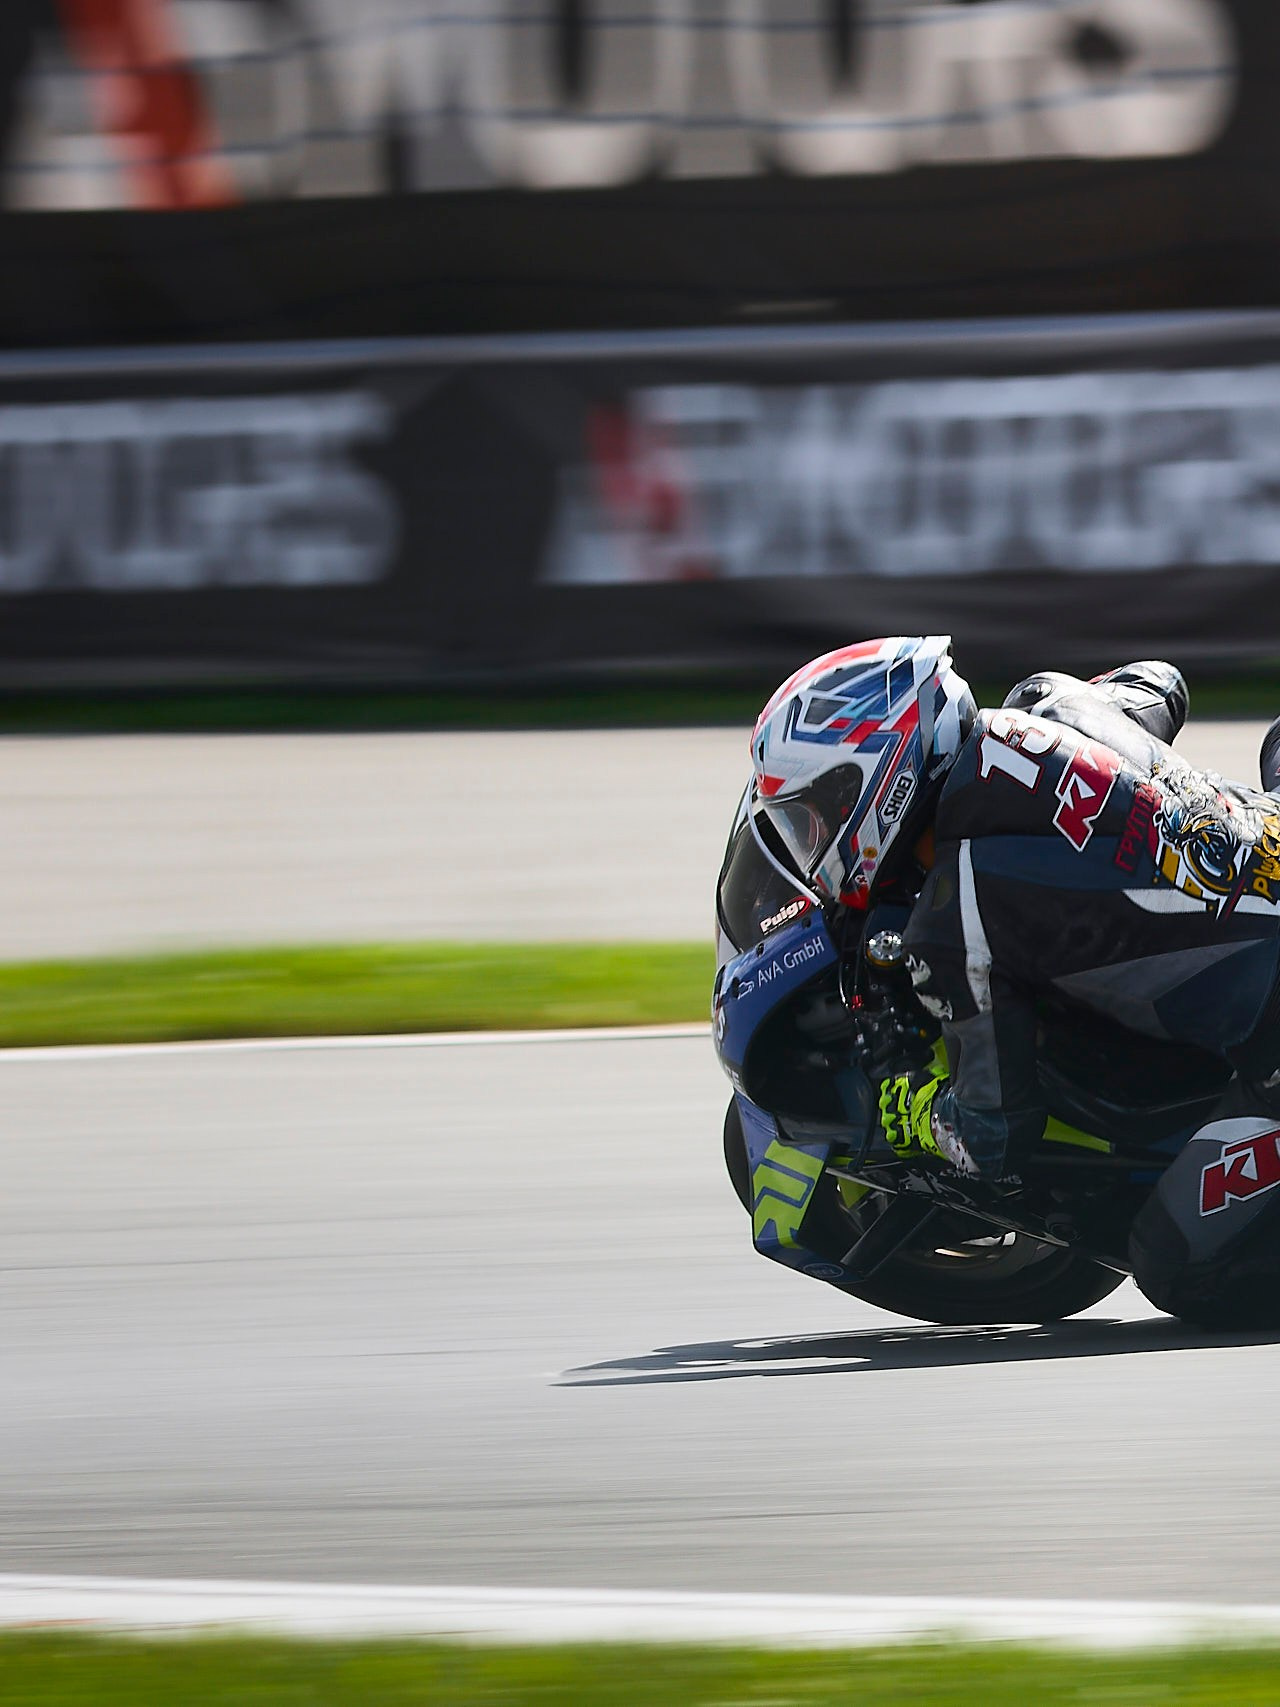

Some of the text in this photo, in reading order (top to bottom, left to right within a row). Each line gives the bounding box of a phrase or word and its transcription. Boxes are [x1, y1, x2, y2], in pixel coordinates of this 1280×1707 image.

[883, 774, 916, 821] SHOEI
[760, 900, 800, 933] Puig
[758, 936, 825, 988] AvA GmbH
